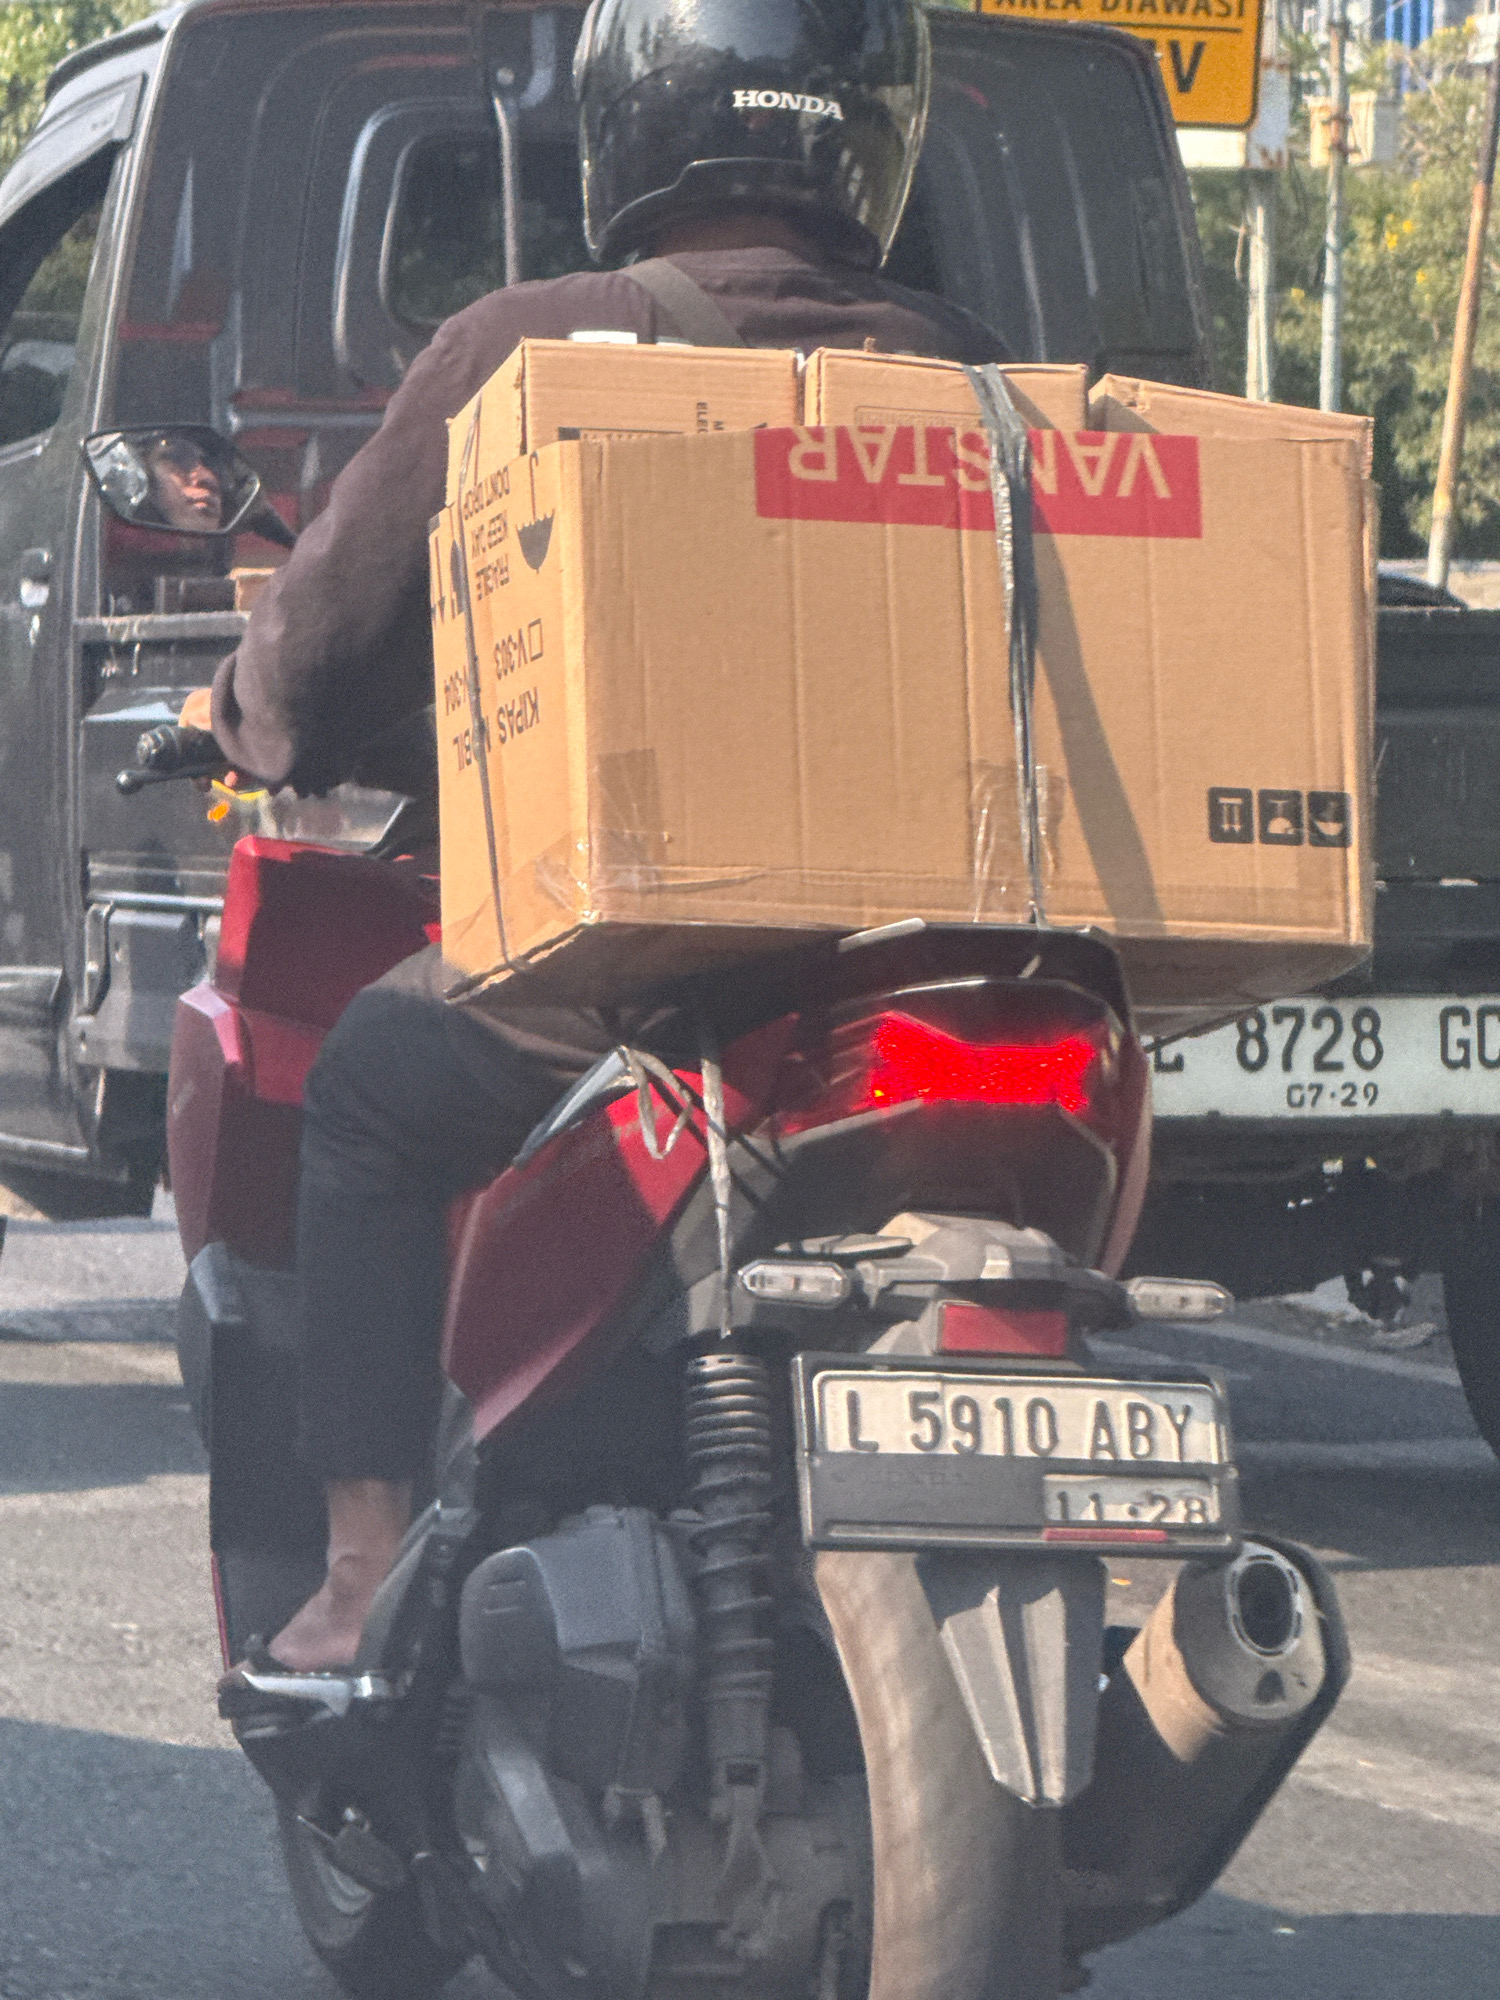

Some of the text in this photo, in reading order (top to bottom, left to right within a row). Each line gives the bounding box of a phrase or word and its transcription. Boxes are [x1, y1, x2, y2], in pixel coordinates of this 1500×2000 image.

[732, 90, 845, 121] HONDA
[788, 425, 1172, 499] VANSTAR
[453, 686, 541, 771] KIPAS BIL
[1236, 1005, 1385, 1073] 8728
[846, 1389, 880, 1452] L
[908, 1391, 1061, 1457] 5910
[1089, 1399, 1193, 1463] ABY
